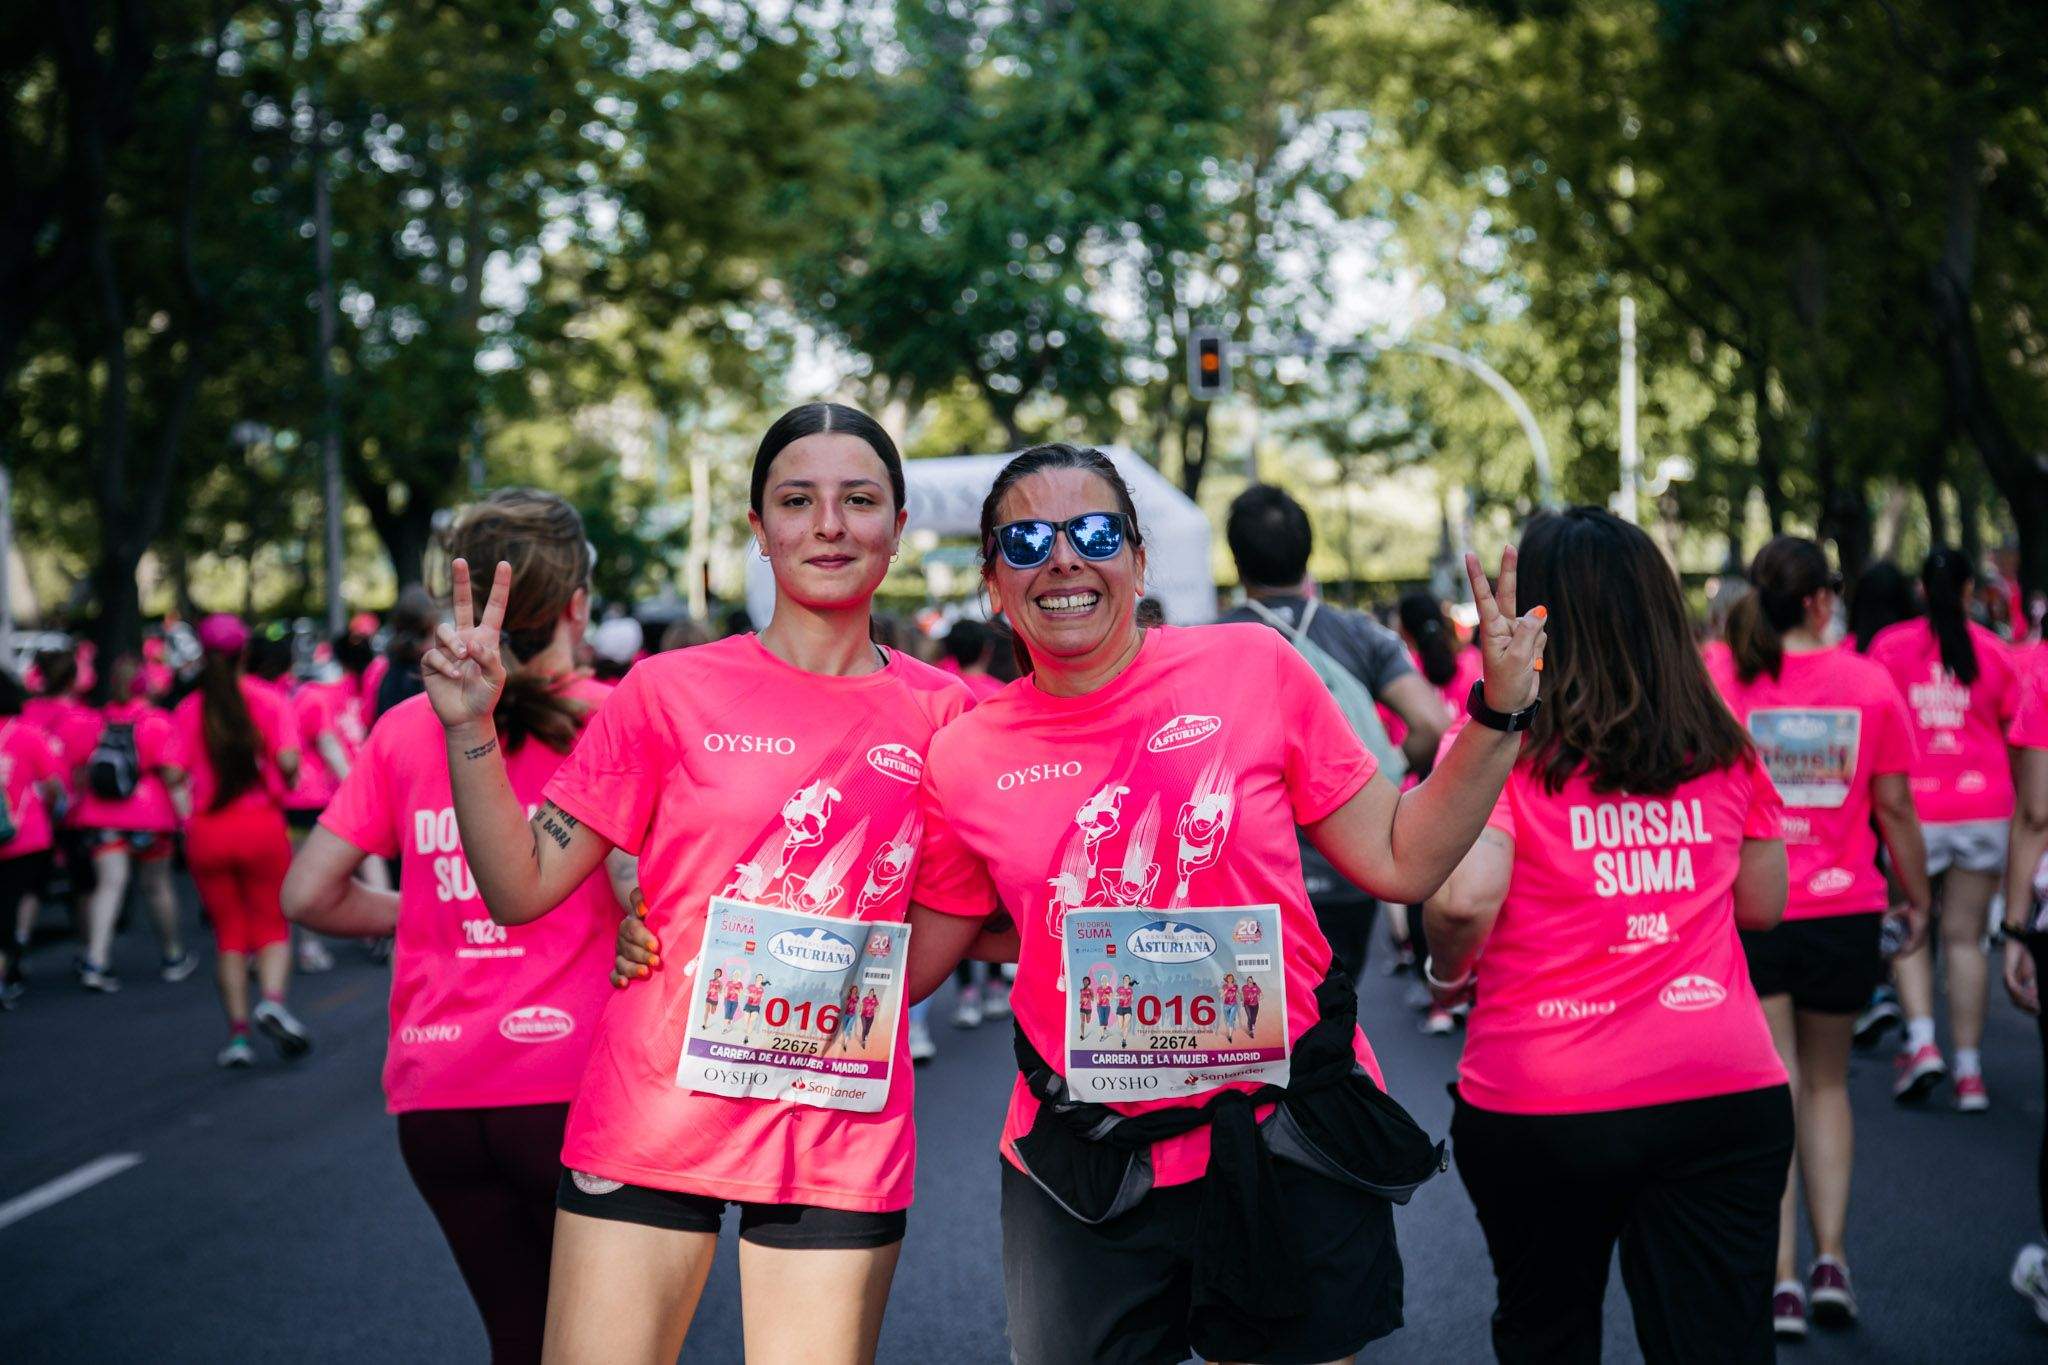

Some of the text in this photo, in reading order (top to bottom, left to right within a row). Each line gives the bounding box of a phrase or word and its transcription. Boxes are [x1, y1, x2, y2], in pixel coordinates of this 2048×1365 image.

[703, 733, 796, 755] OYSHO
[1153, 721, 1218, 750] ASTURIANA
[996, 760, 1083, 791] OYSHO
[543, 818, 571, 849] BORRA
[1569, 798, 1713, 851] DORSAL
[432, 854, 480, 902] SU
[1593, 847, 1696, 898] SUMA
[721, 920, 755, 935] SUMA
[1077, 928, 1113, 939] SUMA
[1239, 920, 1257, 935] 20
[1626, 911, 1670, 942] 2024
[773, 938, 852, 965] ASTURIANA
[871, 935, 889, 949] 20
[1133, 936, 1213, 953] ASTURIANA
[764, 997, 841, 1035] 016
[1137, 995, 1217, 1027] 016
[771, 1037, 818, 1054] 22675
[1150, 1036, 1198, 1049] 22674
[709, 1044, 756, 1061] CARRERA
[758, 1053, 772, 1063] DE
[773, 1054, 787, 1065] LA
[789, 1056, 824, 1070] MUJER
[831, 1061, 869, 1075] MADRID
[1091, 1053, 1139, 1065] CARRERA
[1140, 1054, 1154, 1065] DE
[1156, 1054, 1170, 1064] LA
[1173, 1053, 1209, 1064] MUJER
[1217, 1052, 1261, 1063] MADRID
[704, 1067, 768, 1085] OYSHO
[1091, 1075, 1158, 1090] OYSHO
[1200, 1067, 1265, 1081] Santander
[807, 1081, 867, 1099] Santander
